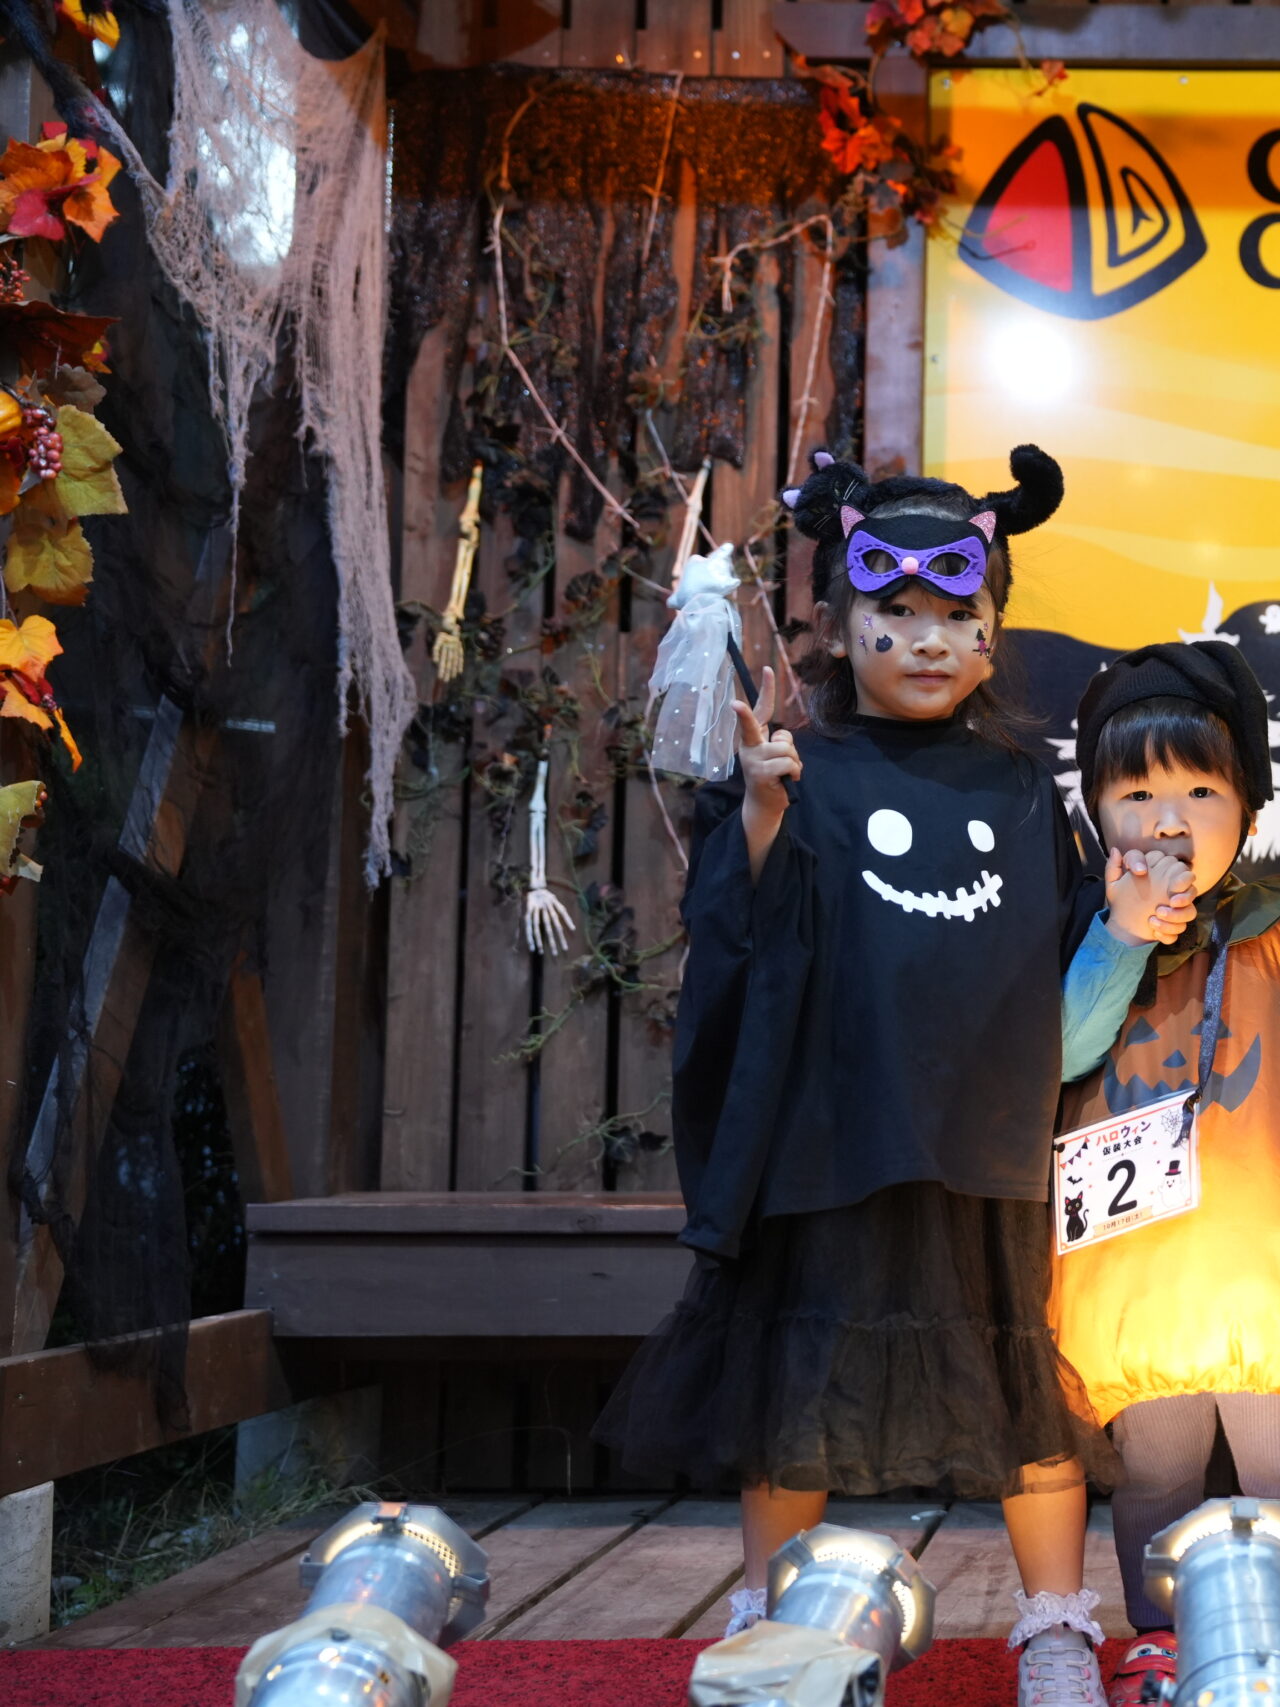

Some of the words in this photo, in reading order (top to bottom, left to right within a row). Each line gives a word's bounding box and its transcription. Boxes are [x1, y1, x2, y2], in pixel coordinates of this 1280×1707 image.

[1096, 1121, 1151, 1146] ハロウィン
[1103, 1136, 1142, 1155] 仮装大会
[1107, 1159, 1138, 1217] 2
